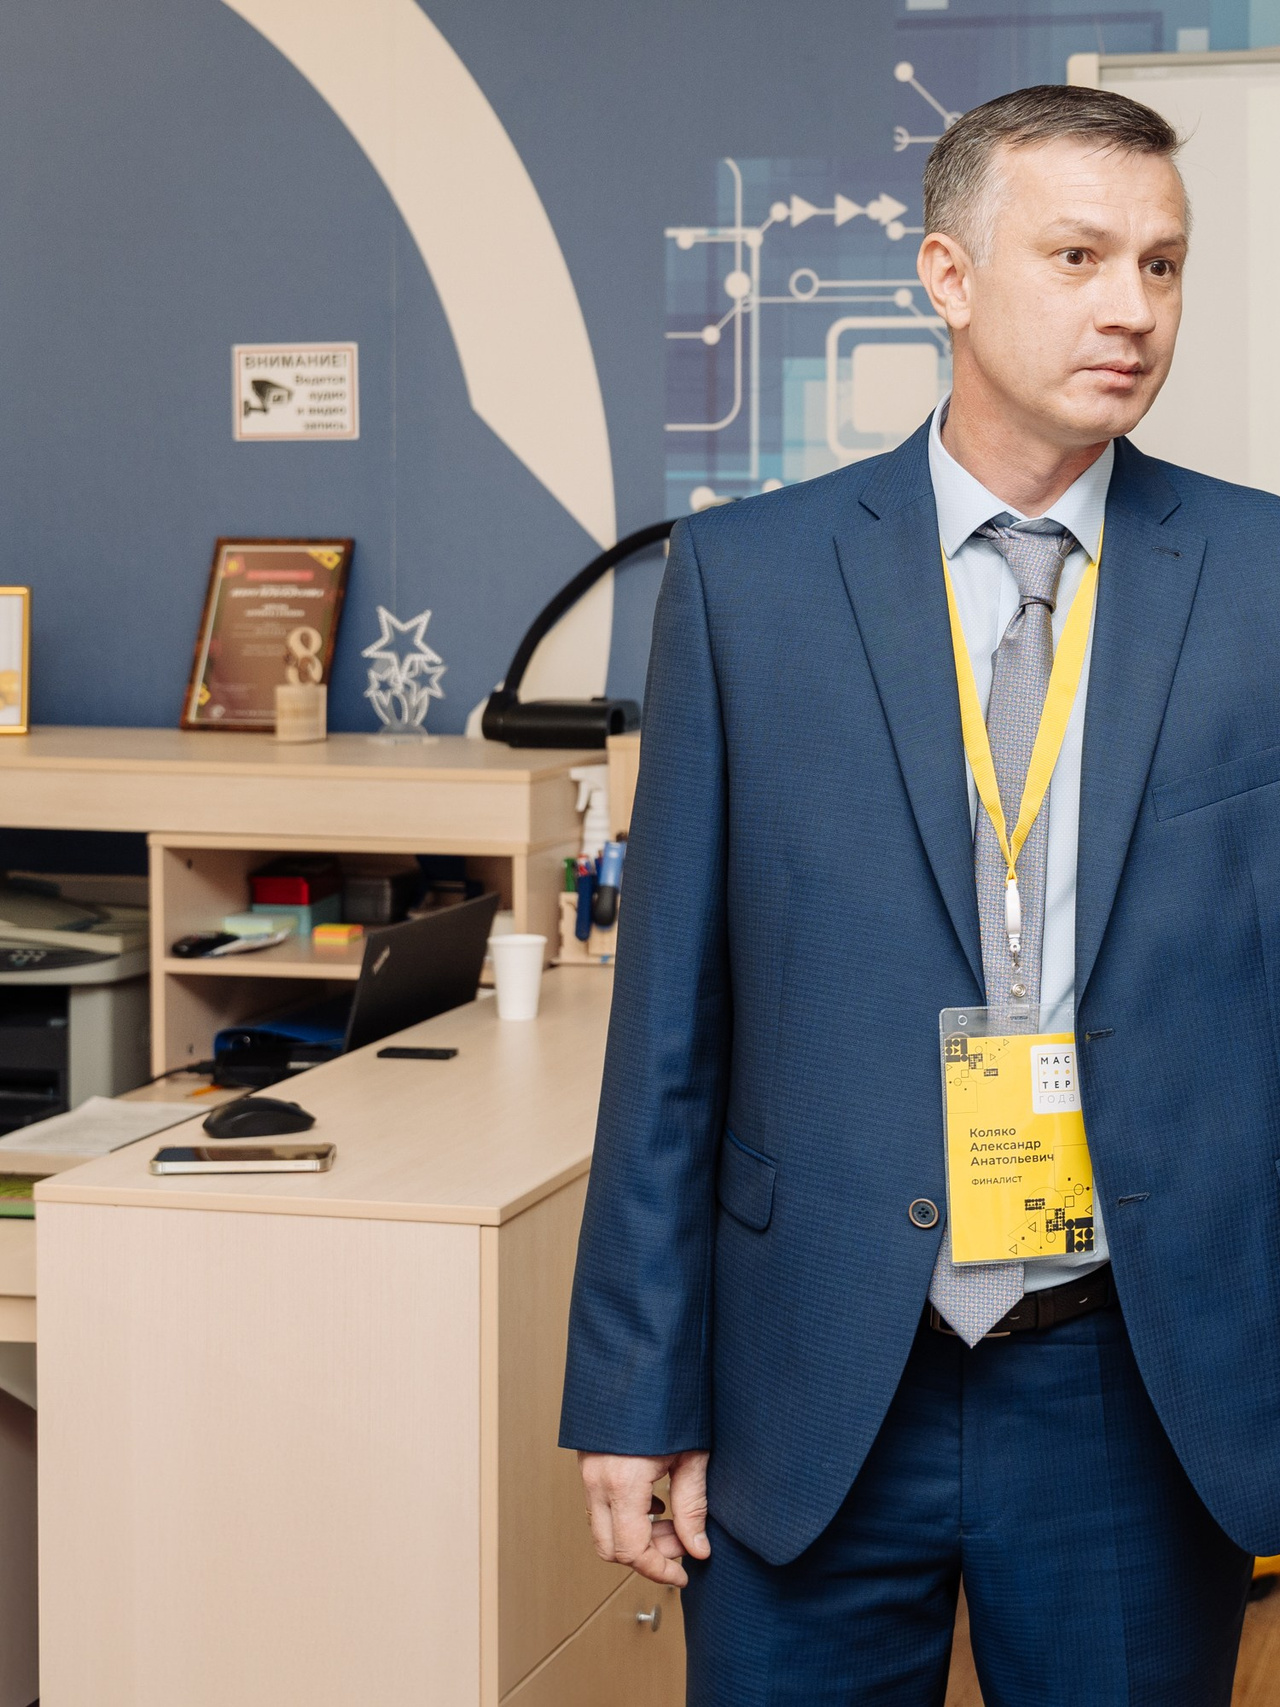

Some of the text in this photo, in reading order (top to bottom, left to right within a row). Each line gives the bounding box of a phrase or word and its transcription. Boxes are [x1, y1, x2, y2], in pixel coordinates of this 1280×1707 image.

[245, 354, 347, 368] ВНИМАНИЕ!
[1040, 1056, 1070, 1065] МАС
[1042, 1080, 1071, 1089] ТЕР
[1039, 1094, 1076, 1104] года
[969, 1128, 1017, 1138] Коляко
[970, 1140, 1042, 1152] Александр
[970, 1154, 1055, 1166] Анатольевич
[971, 1176, 1023, 1185] ФИНАЛИСТ
